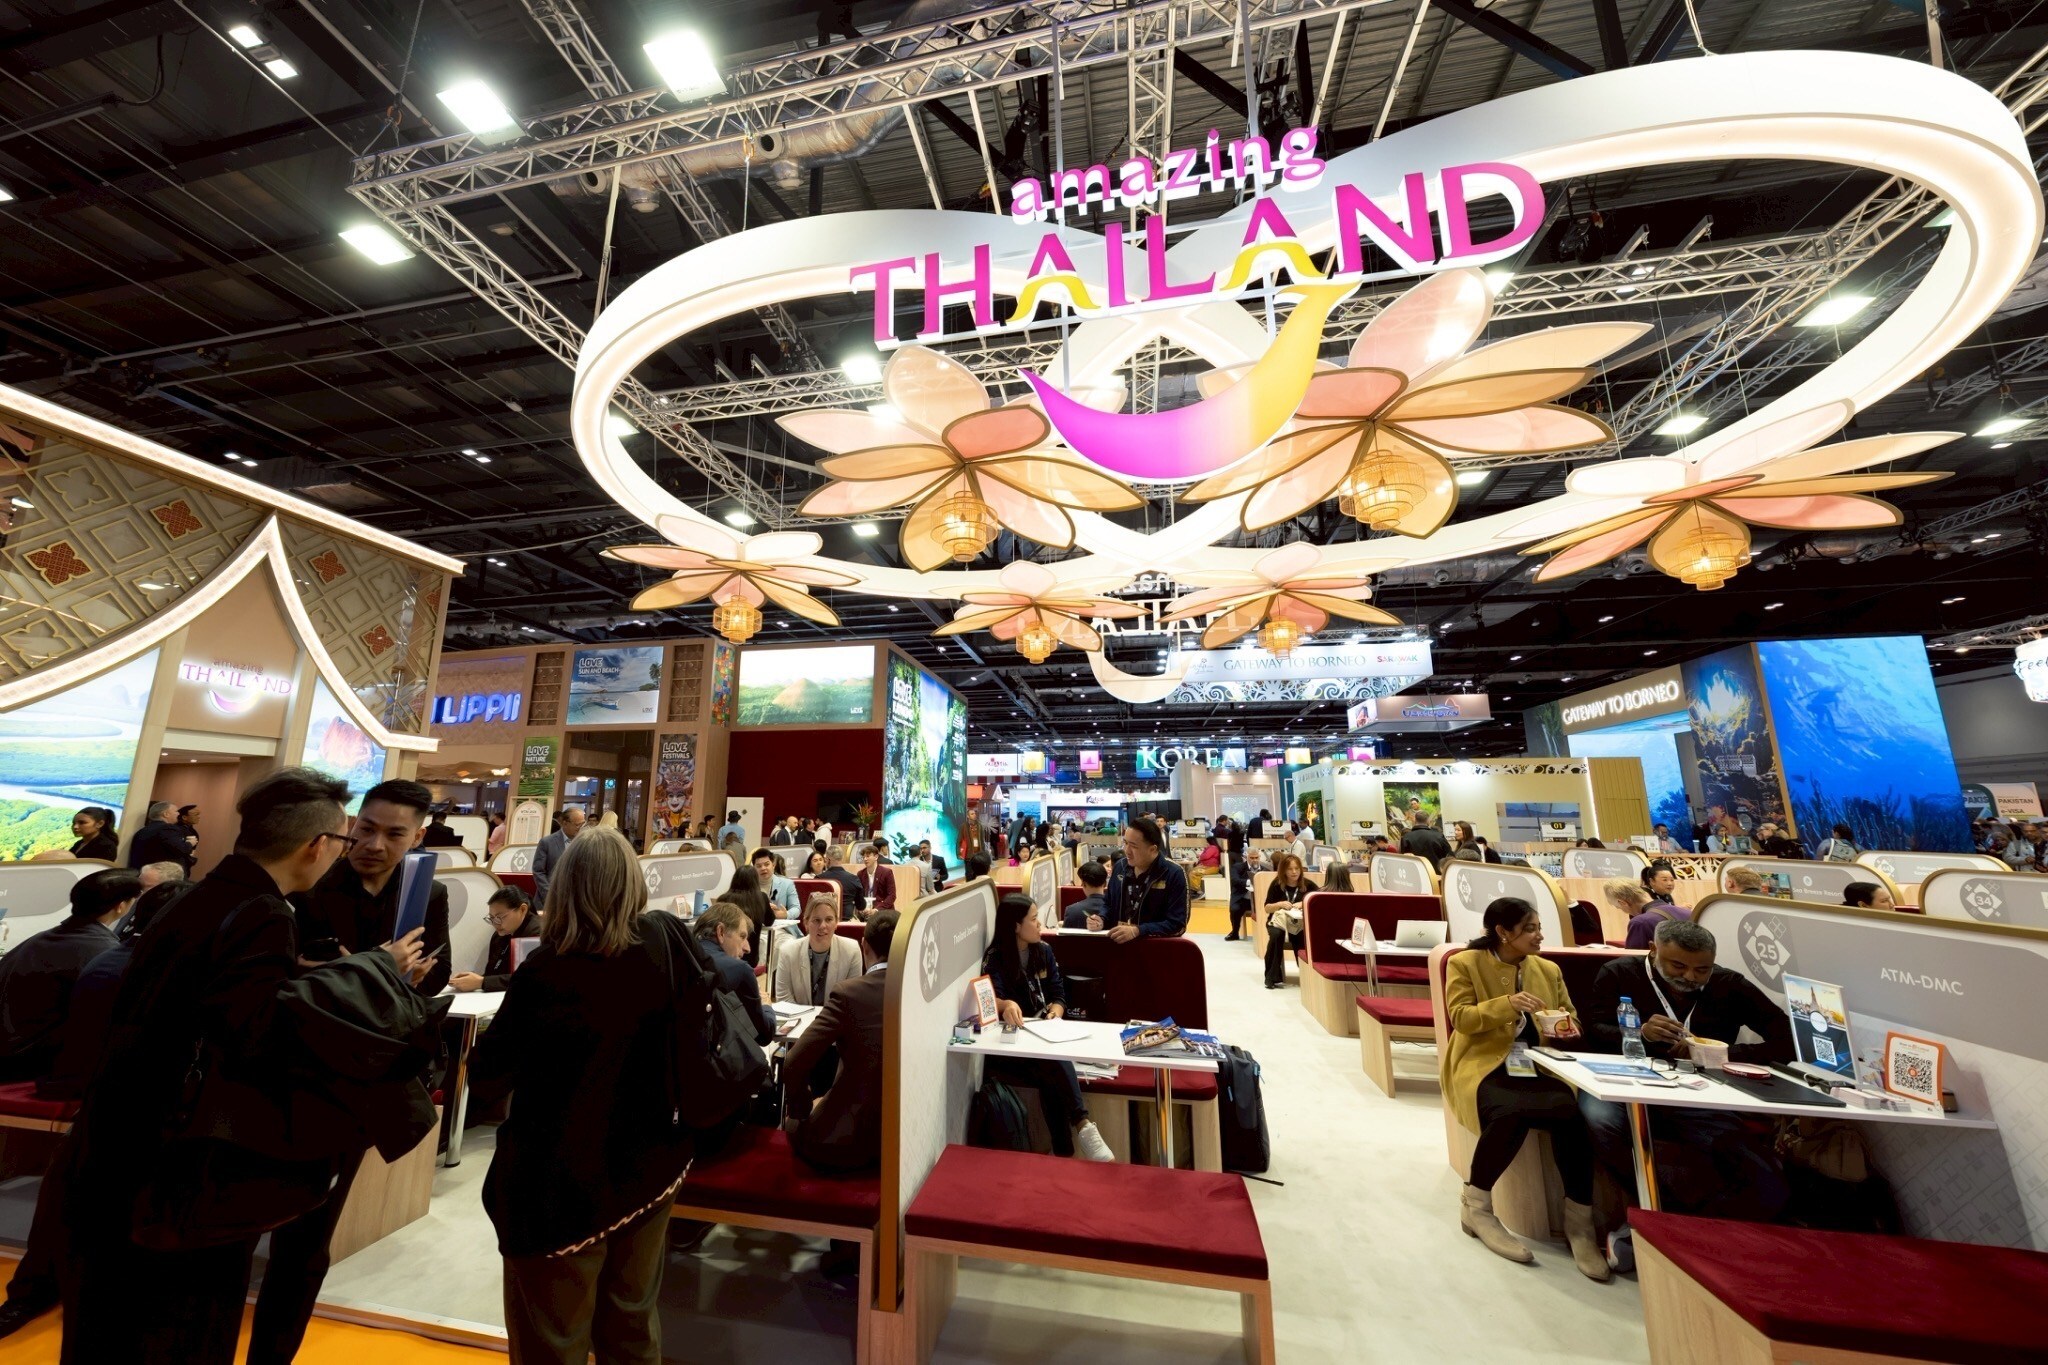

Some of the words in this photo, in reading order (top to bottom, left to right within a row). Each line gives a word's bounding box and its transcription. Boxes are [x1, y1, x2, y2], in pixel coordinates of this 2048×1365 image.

[1010, 125, 1327, 224] amazing
[849, 161, 1547, 351] THAILAND
[579, 657, 603, 668] LOVE
[1223, 657, 1284, 670] GATEWAY
[1288, 656, 1305, 668] TO
[1308, 655, 1366, 668] BORNEO
[1376, 654, 1418, 663] SARAWAK
[1562, 699, 1606, 725] GATEWAY
[1605, 695, 1624, 714] TO
[1623, 680, 1679, 712] BORNEO
[526, 745, 550, 756] LOVE
[662, 742, 688, 752] LOVE
[1140, 745, 1241, 769] KOREA
[1975, 895, 1992, 907] 34
[1757, 942, 1777, 960] 25
[1880, 967, 1964, 995] ATM-DMC
